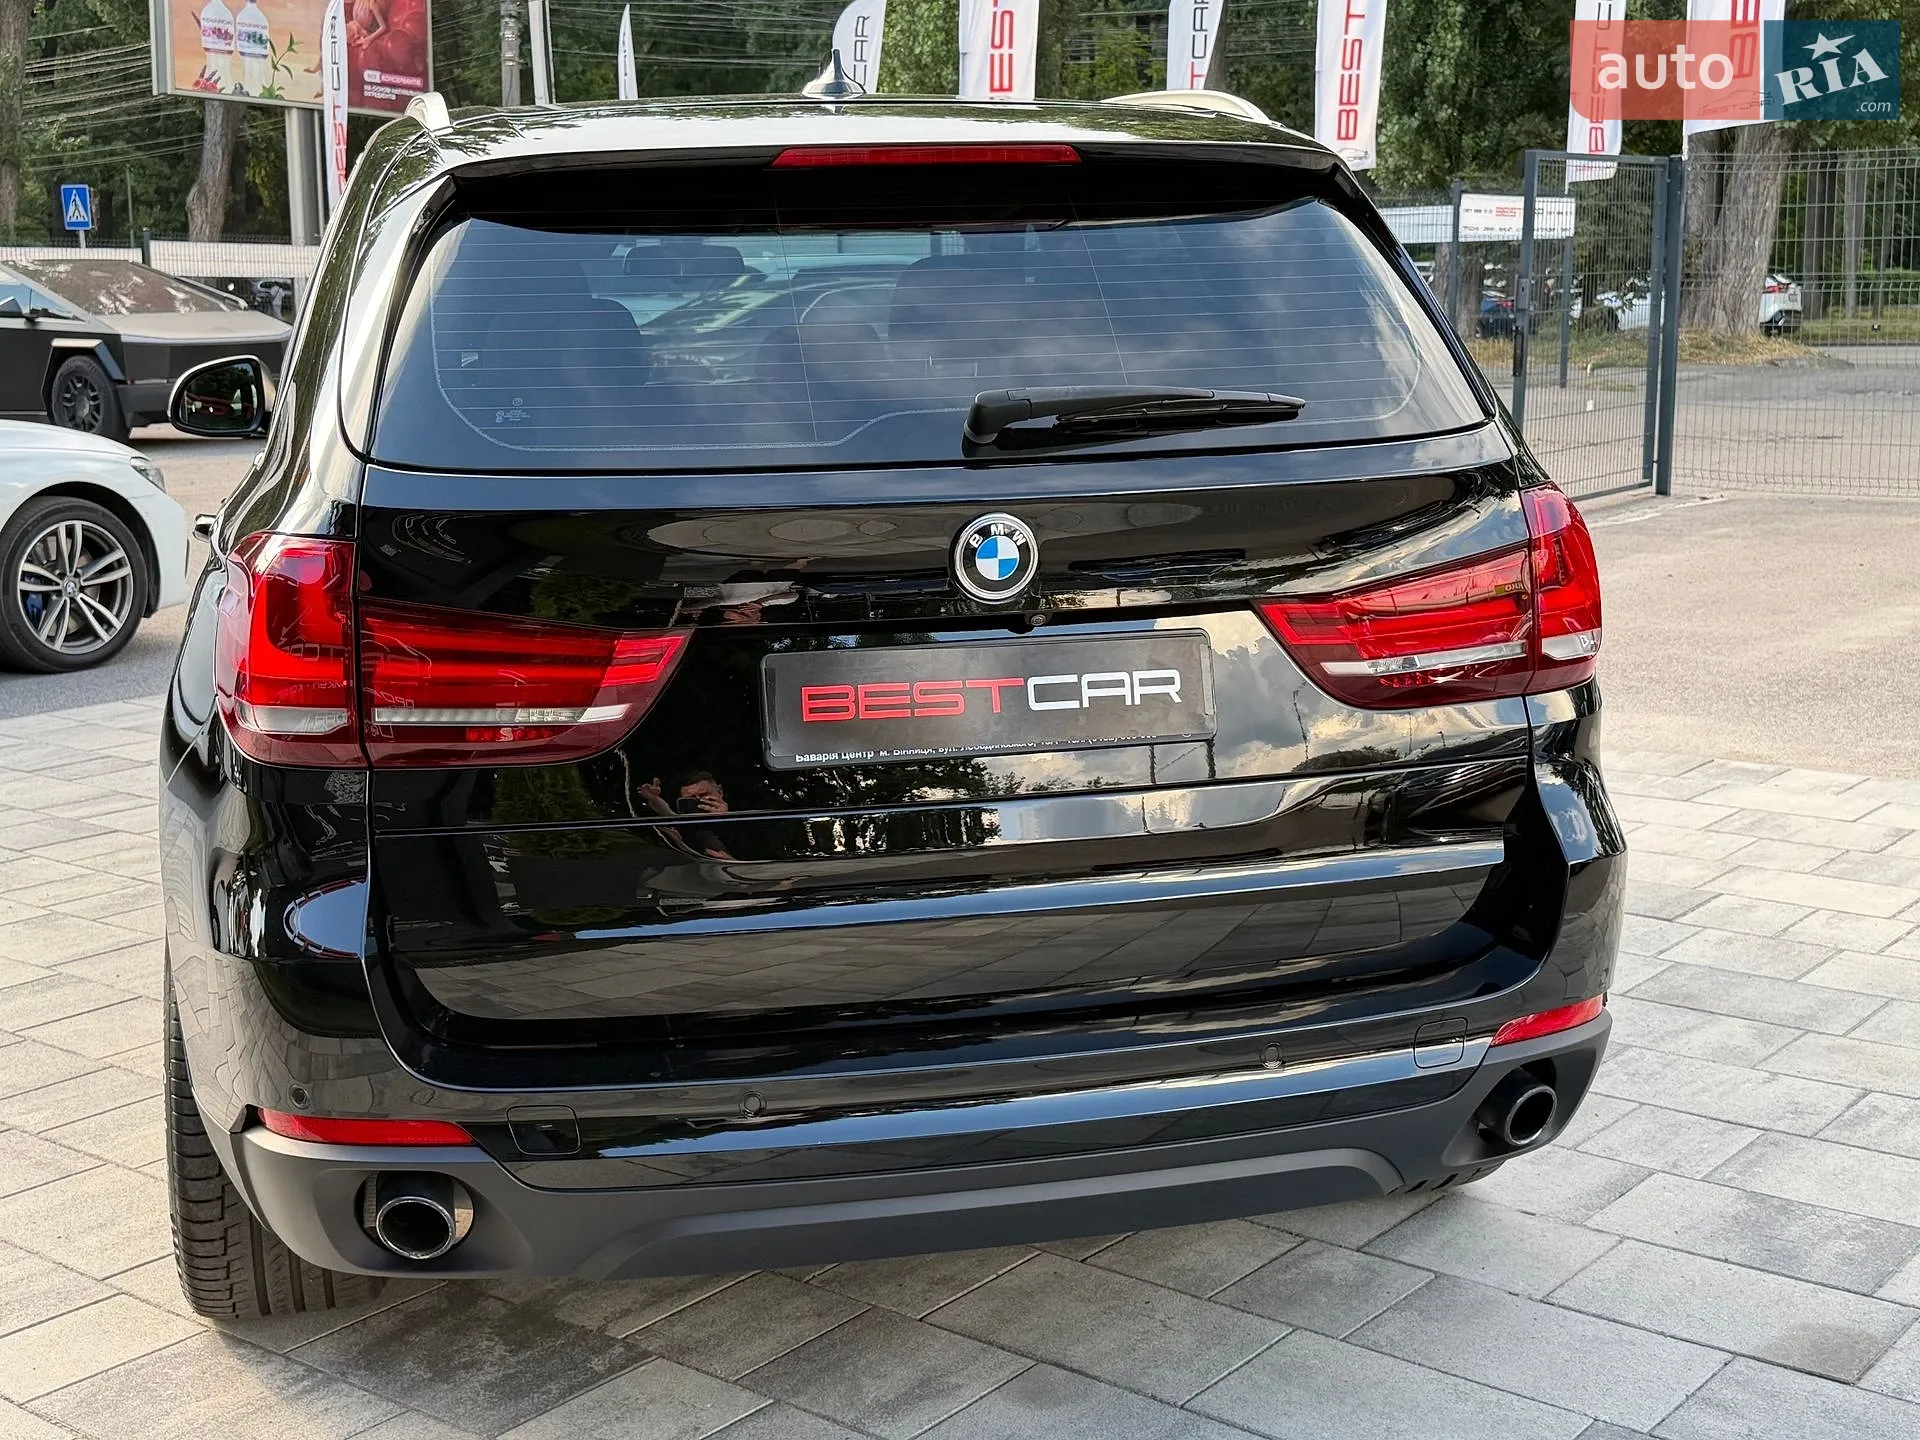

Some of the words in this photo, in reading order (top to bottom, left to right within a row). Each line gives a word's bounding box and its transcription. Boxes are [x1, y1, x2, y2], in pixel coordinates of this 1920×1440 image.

[990, 0, 1013, 99] ES
[1189, 0, 1209, 89] TCA
[1337, 0, 1365, 140] BEST
[1589, 0, 1611, 152] BESTC
[969, 523, 1027, 548] BMW
[801, 669, 1182, 722] BESTCAR
